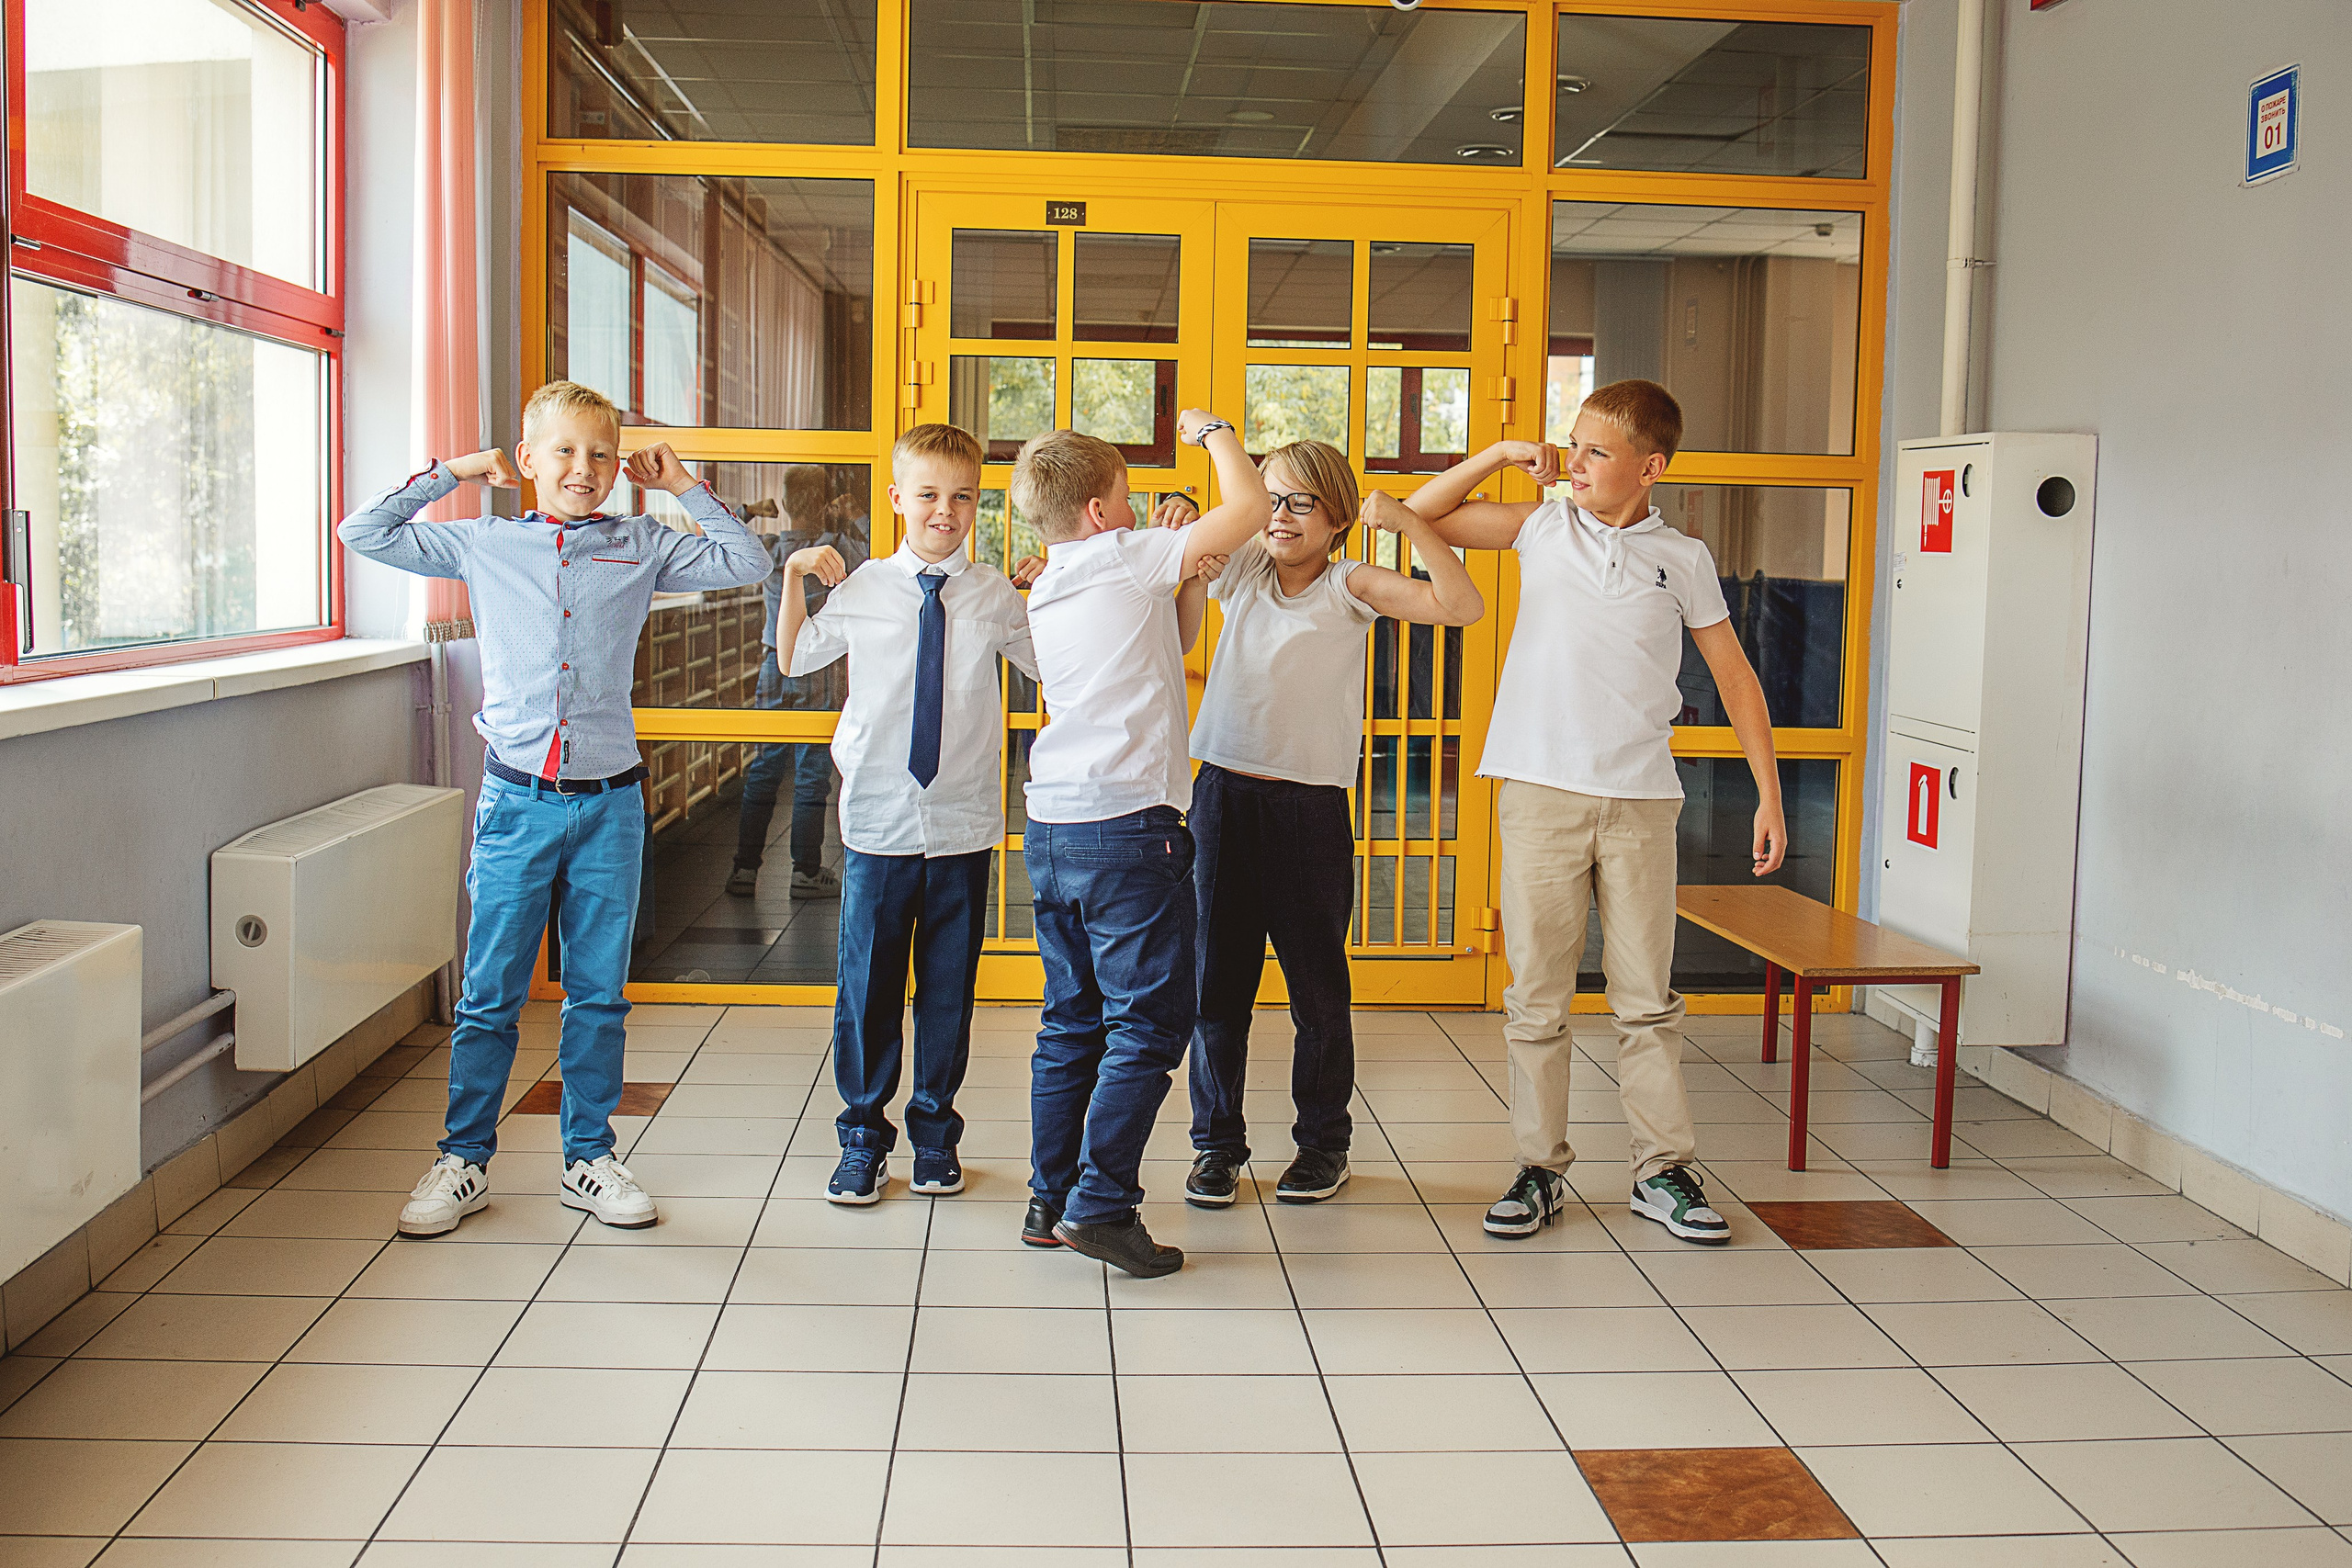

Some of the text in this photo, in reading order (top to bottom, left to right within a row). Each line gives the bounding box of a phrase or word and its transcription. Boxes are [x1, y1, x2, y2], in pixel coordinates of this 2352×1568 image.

[2261, 96, 2286, 113] О ПОЖАРЕ
[2260, 107, 2286, 123] ЗВОНИТЬ
[2265, 121, 2280, 149] 01
[1054, 207, 1078, 220] 128
